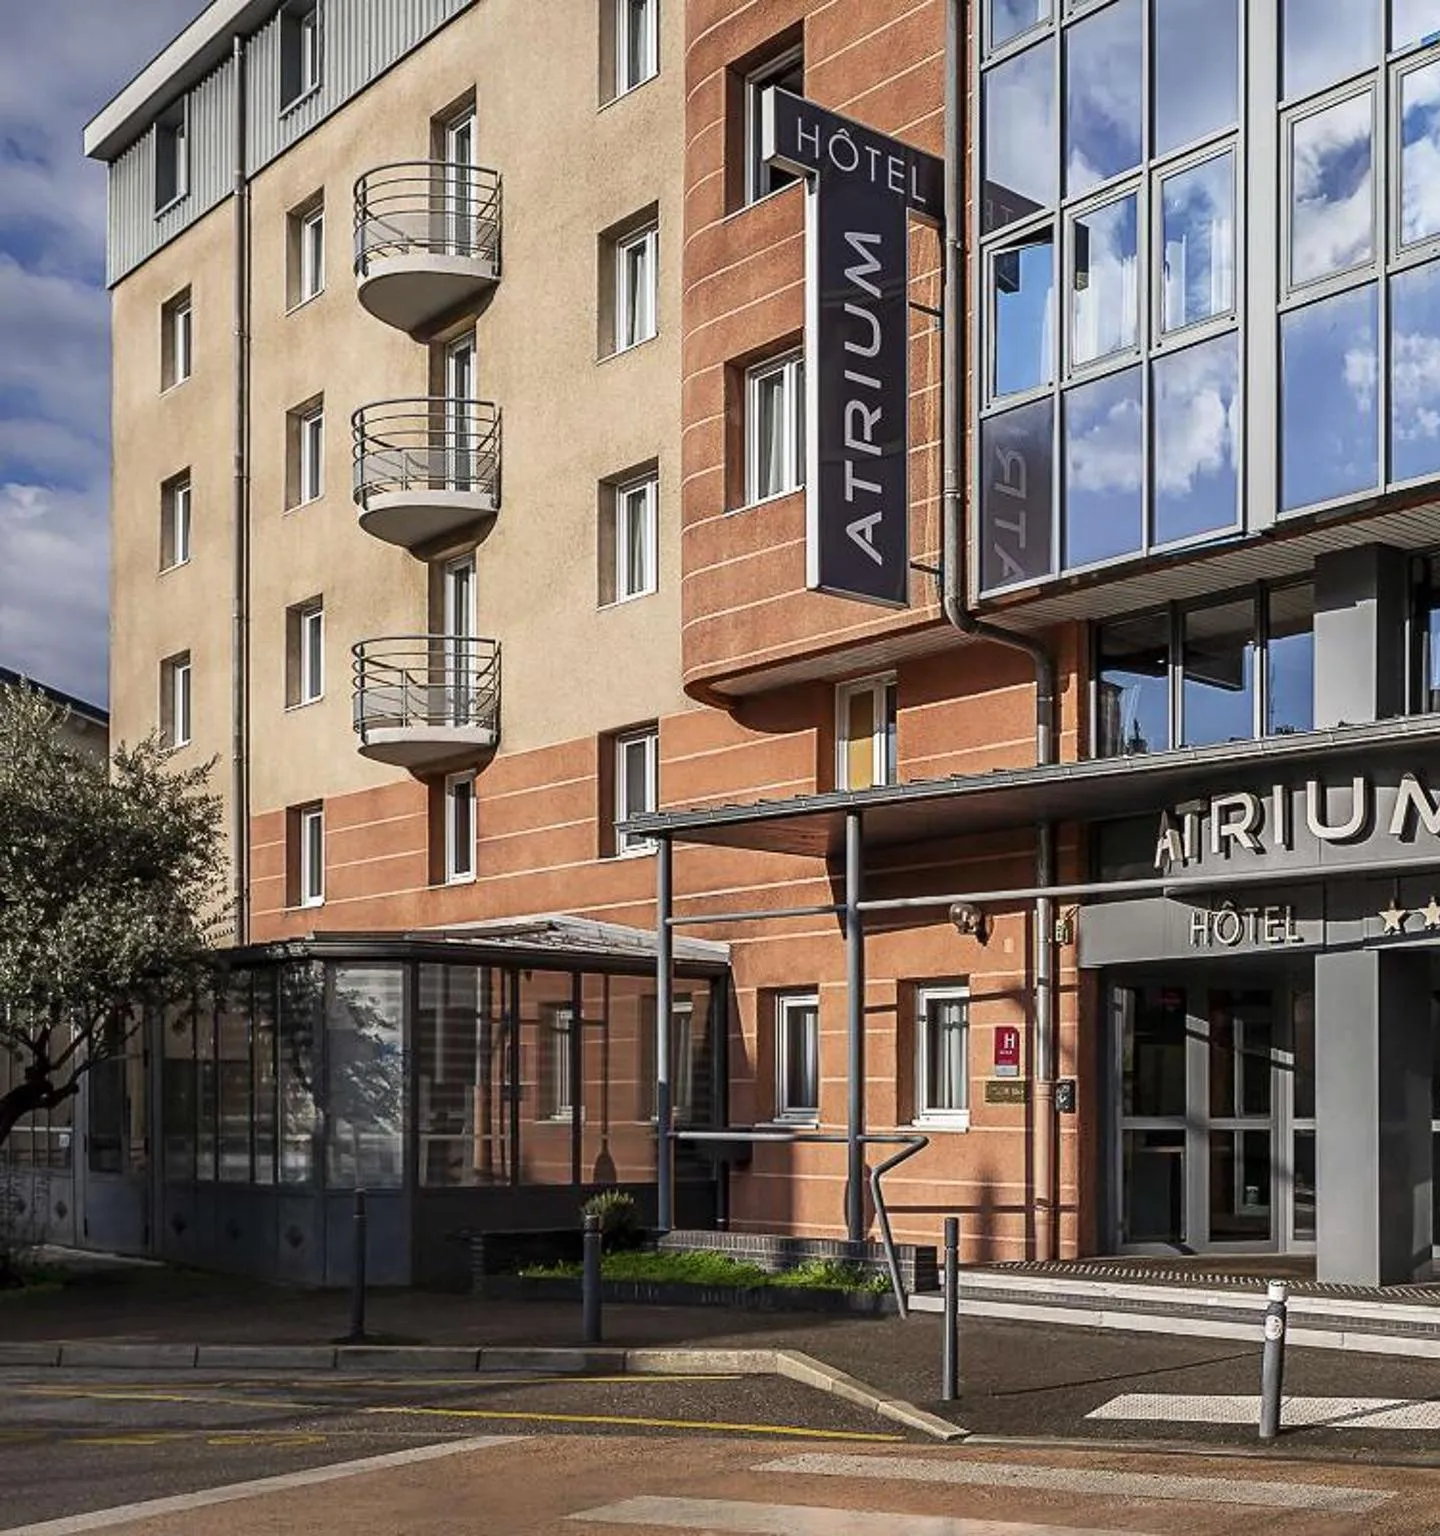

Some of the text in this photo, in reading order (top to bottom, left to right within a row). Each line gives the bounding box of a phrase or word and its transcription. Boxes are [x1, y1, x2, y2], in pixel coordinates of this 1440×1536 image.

[796, 116, 927, 205] HÔTEL
[843, 231, 883, 566] ATRIUM
[1190, 902, 1303, 947] HÔTEL
[1003, 1032, 1016, 1049] H
